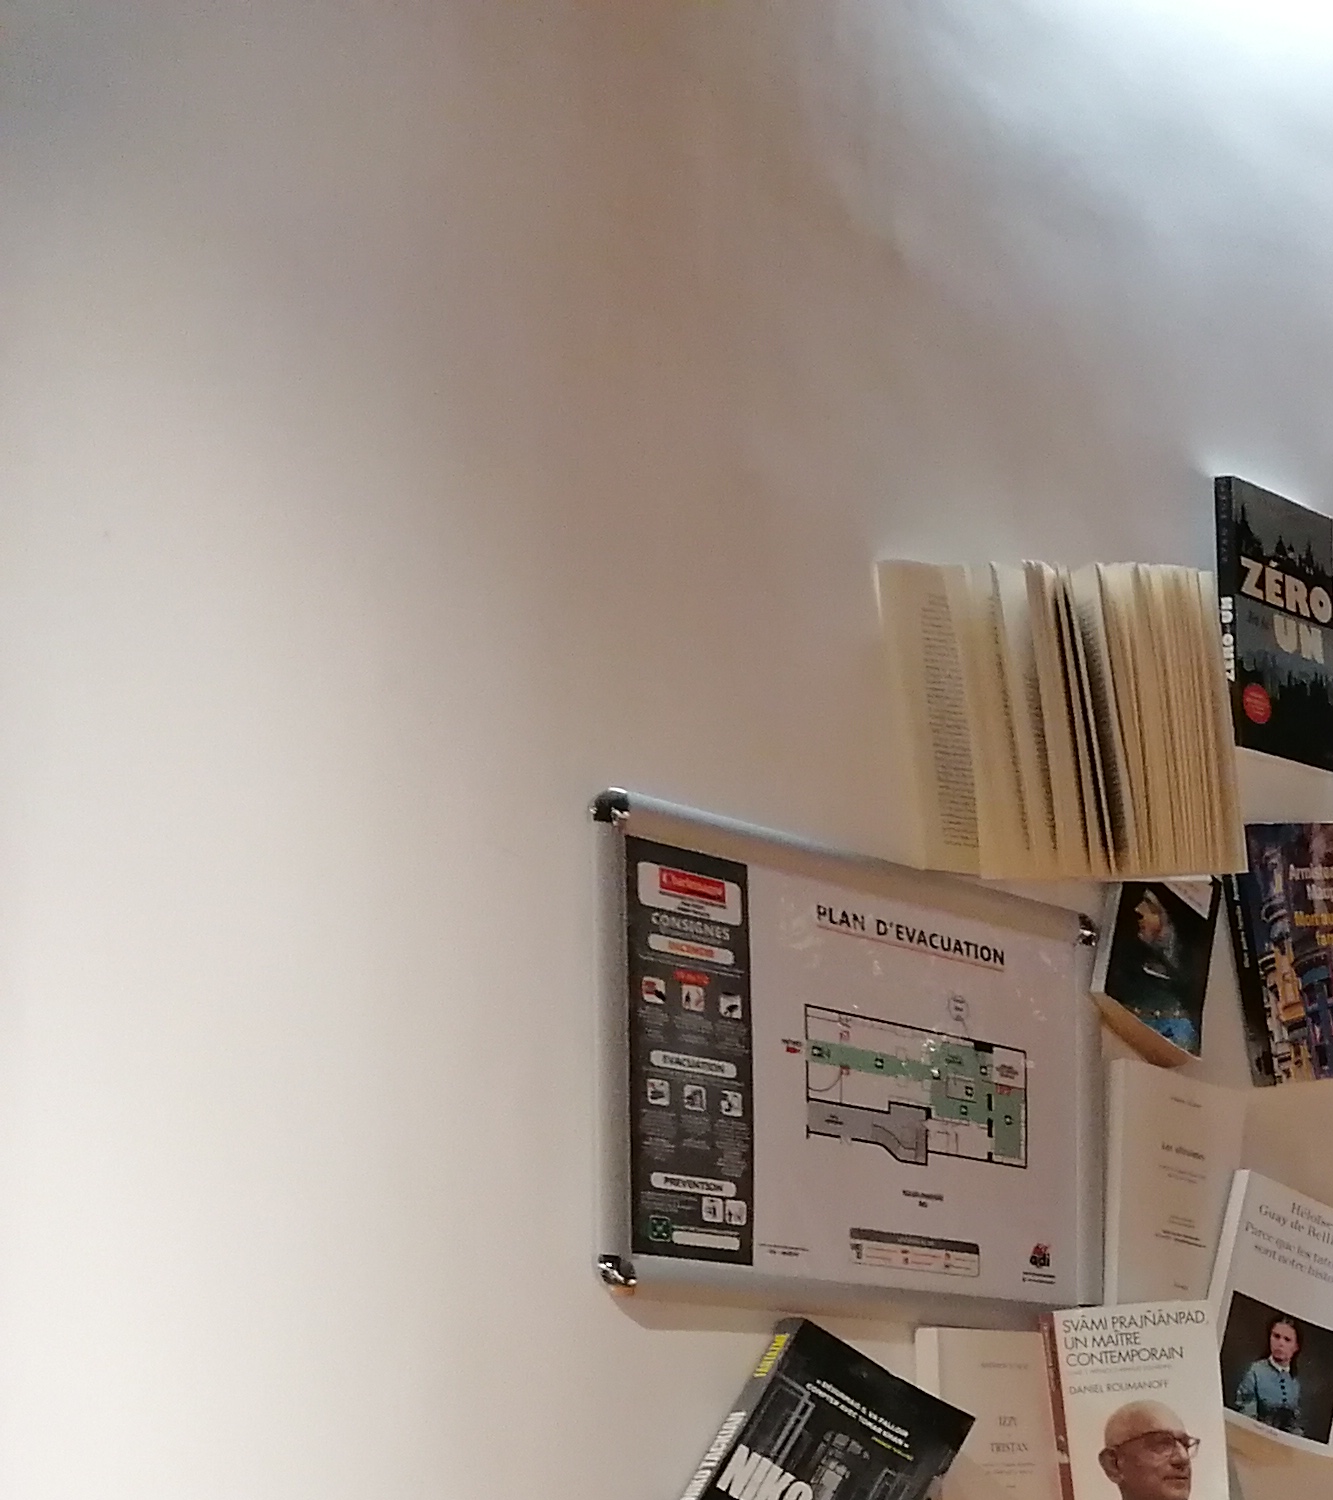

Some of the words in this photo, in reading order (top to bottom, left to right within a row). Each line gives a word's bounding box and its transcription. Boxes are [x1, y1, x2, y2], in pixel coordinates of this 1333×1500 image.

[1240, 554, 1333, 625] ZÉRO
[1273, 613, 1325, 665] UN
[651, 912, 731, 941] CONSIGNES
[816, 904, 866, 932] PLAN
[876, 918, 1005, 966] D'EVACUATION
[1259, 1203, 1288, 1227] Guay
[1290, 1219, 1305, 1233] de
[1064, 1336, 1088, 1350] UN
[1066, 1346, 1184, 1368] CONTEMPORAIN
[1069, 1383, 1105, 1396] DANIEL
[1106, 1379, 1170, 1393] ROUMANOFF
